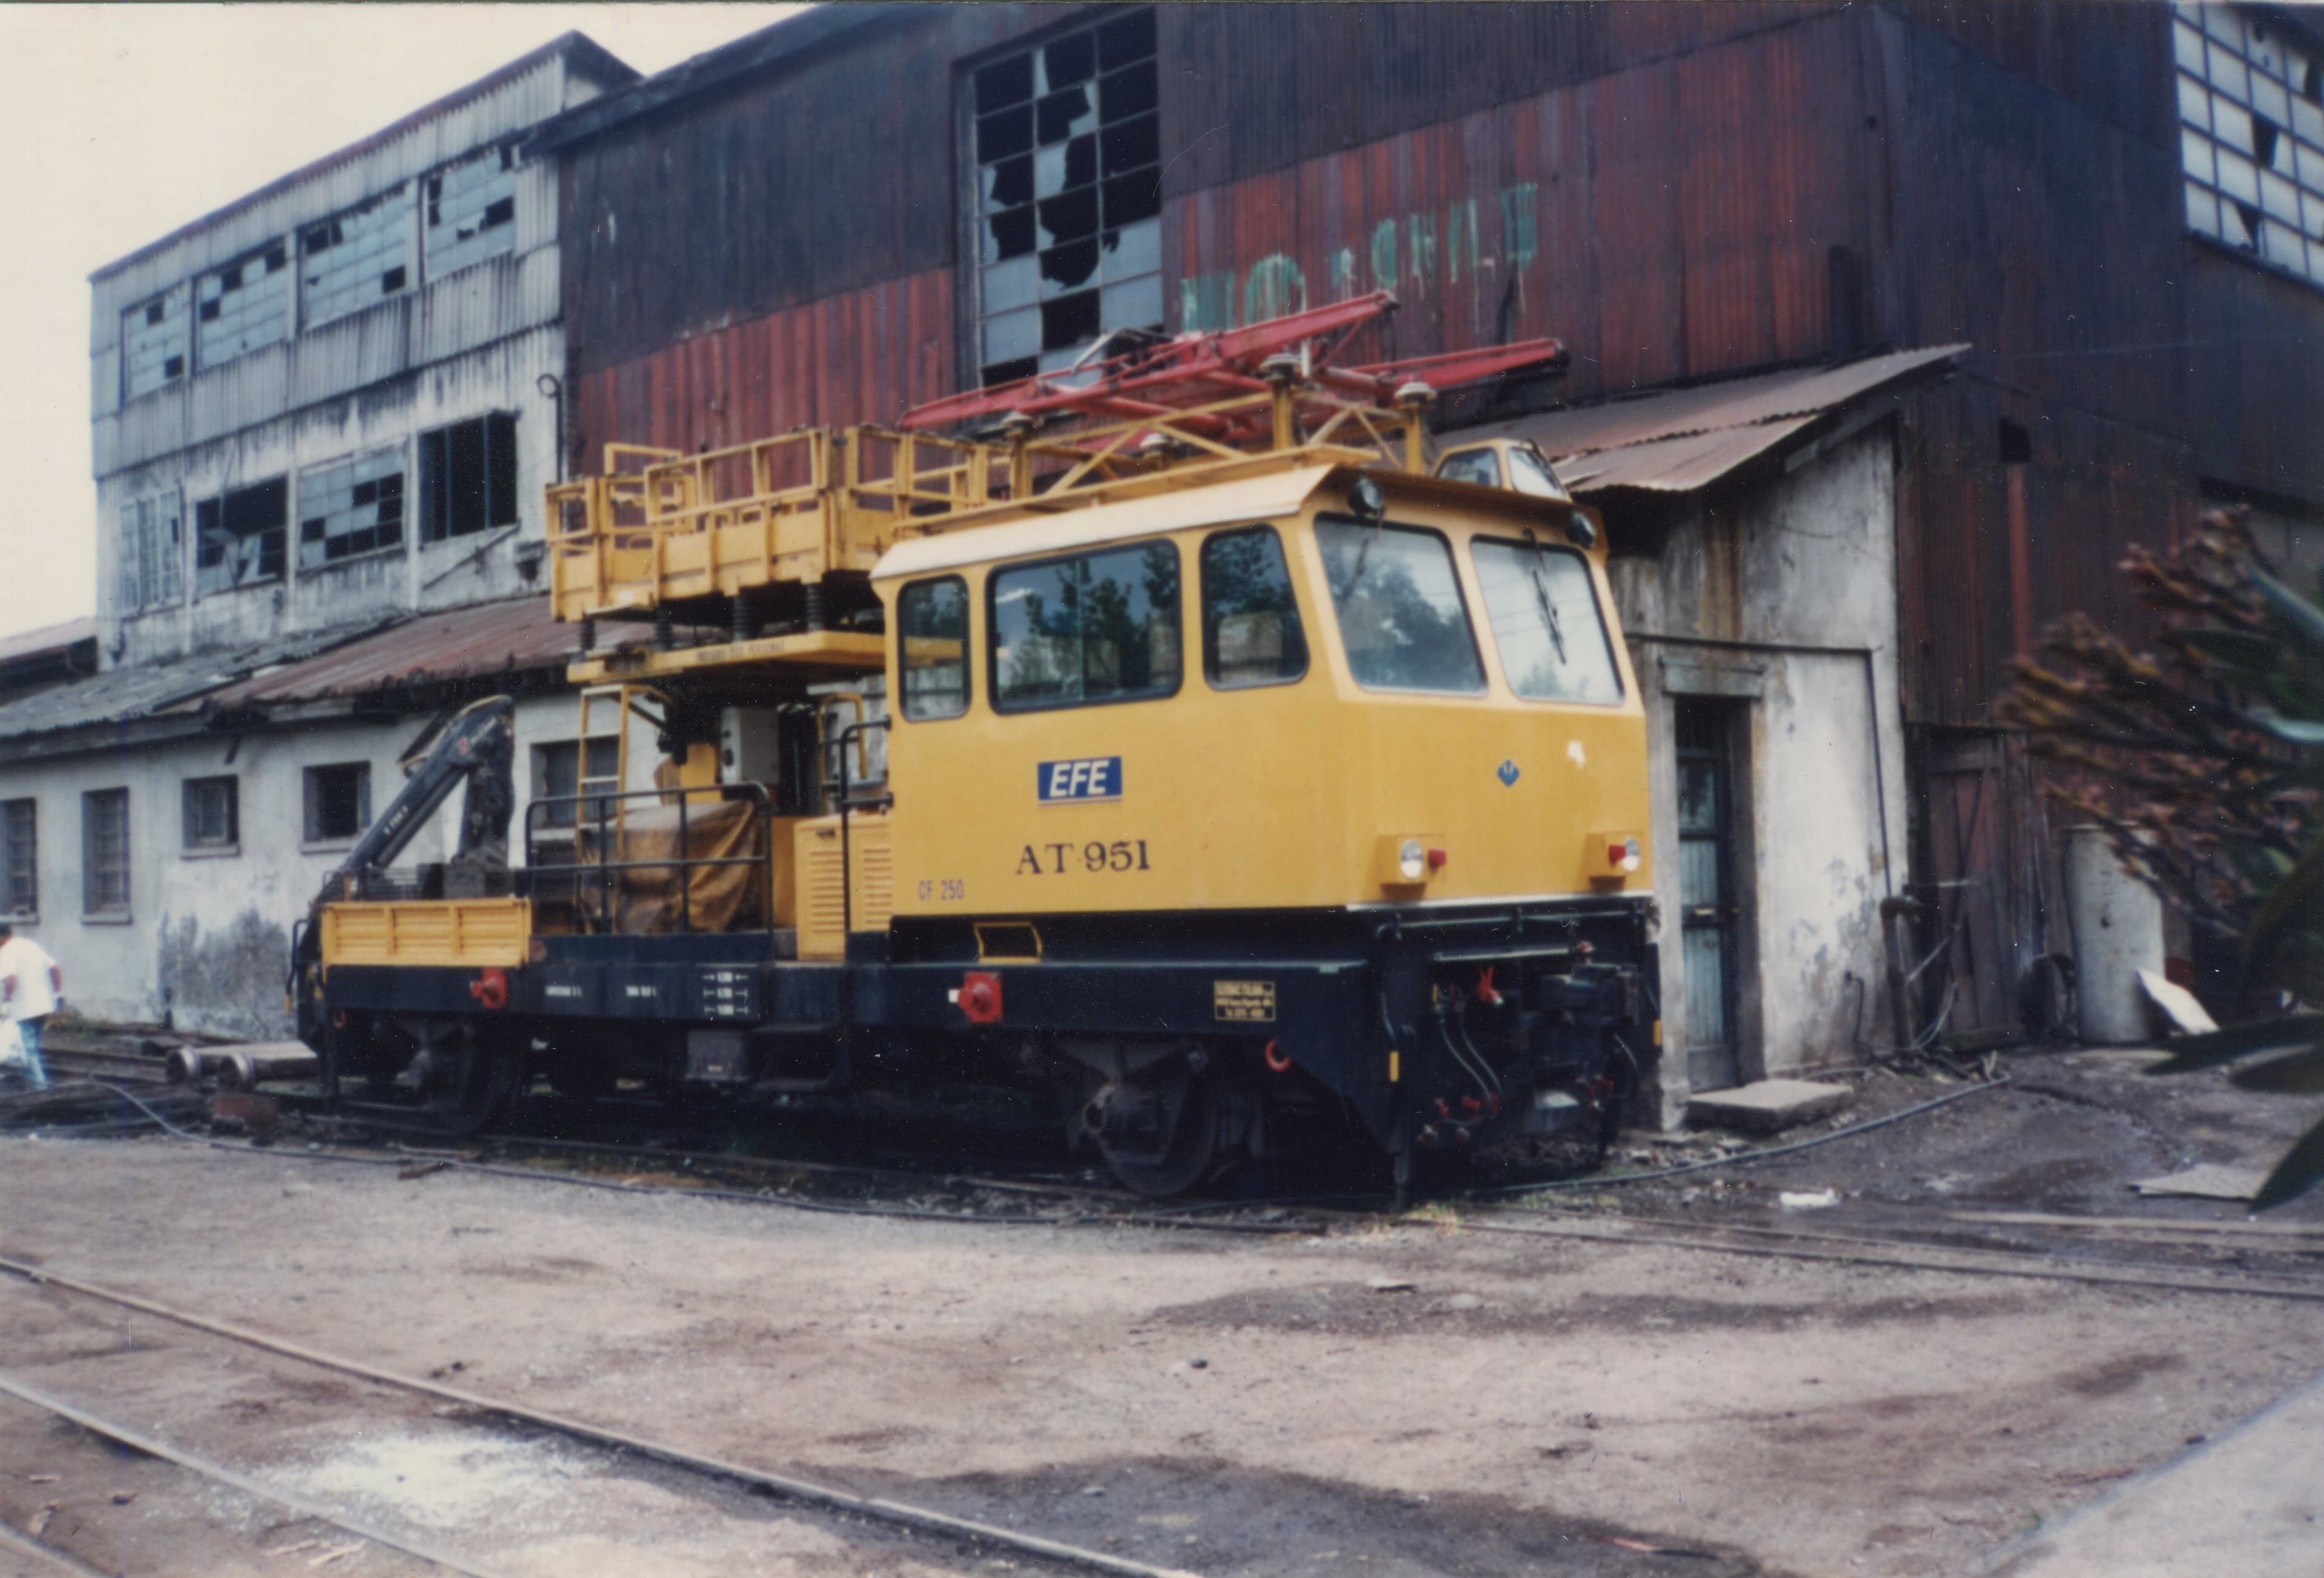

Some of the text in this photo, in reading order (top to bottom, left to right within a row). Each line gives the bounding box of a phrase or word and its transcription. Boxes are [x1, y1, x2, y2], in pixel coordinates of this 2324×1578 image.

[1049, 760, 1110, 798] EFE
[1015, 839, 1151, 876] AT 951
[940, 879, 965, 901] 250
